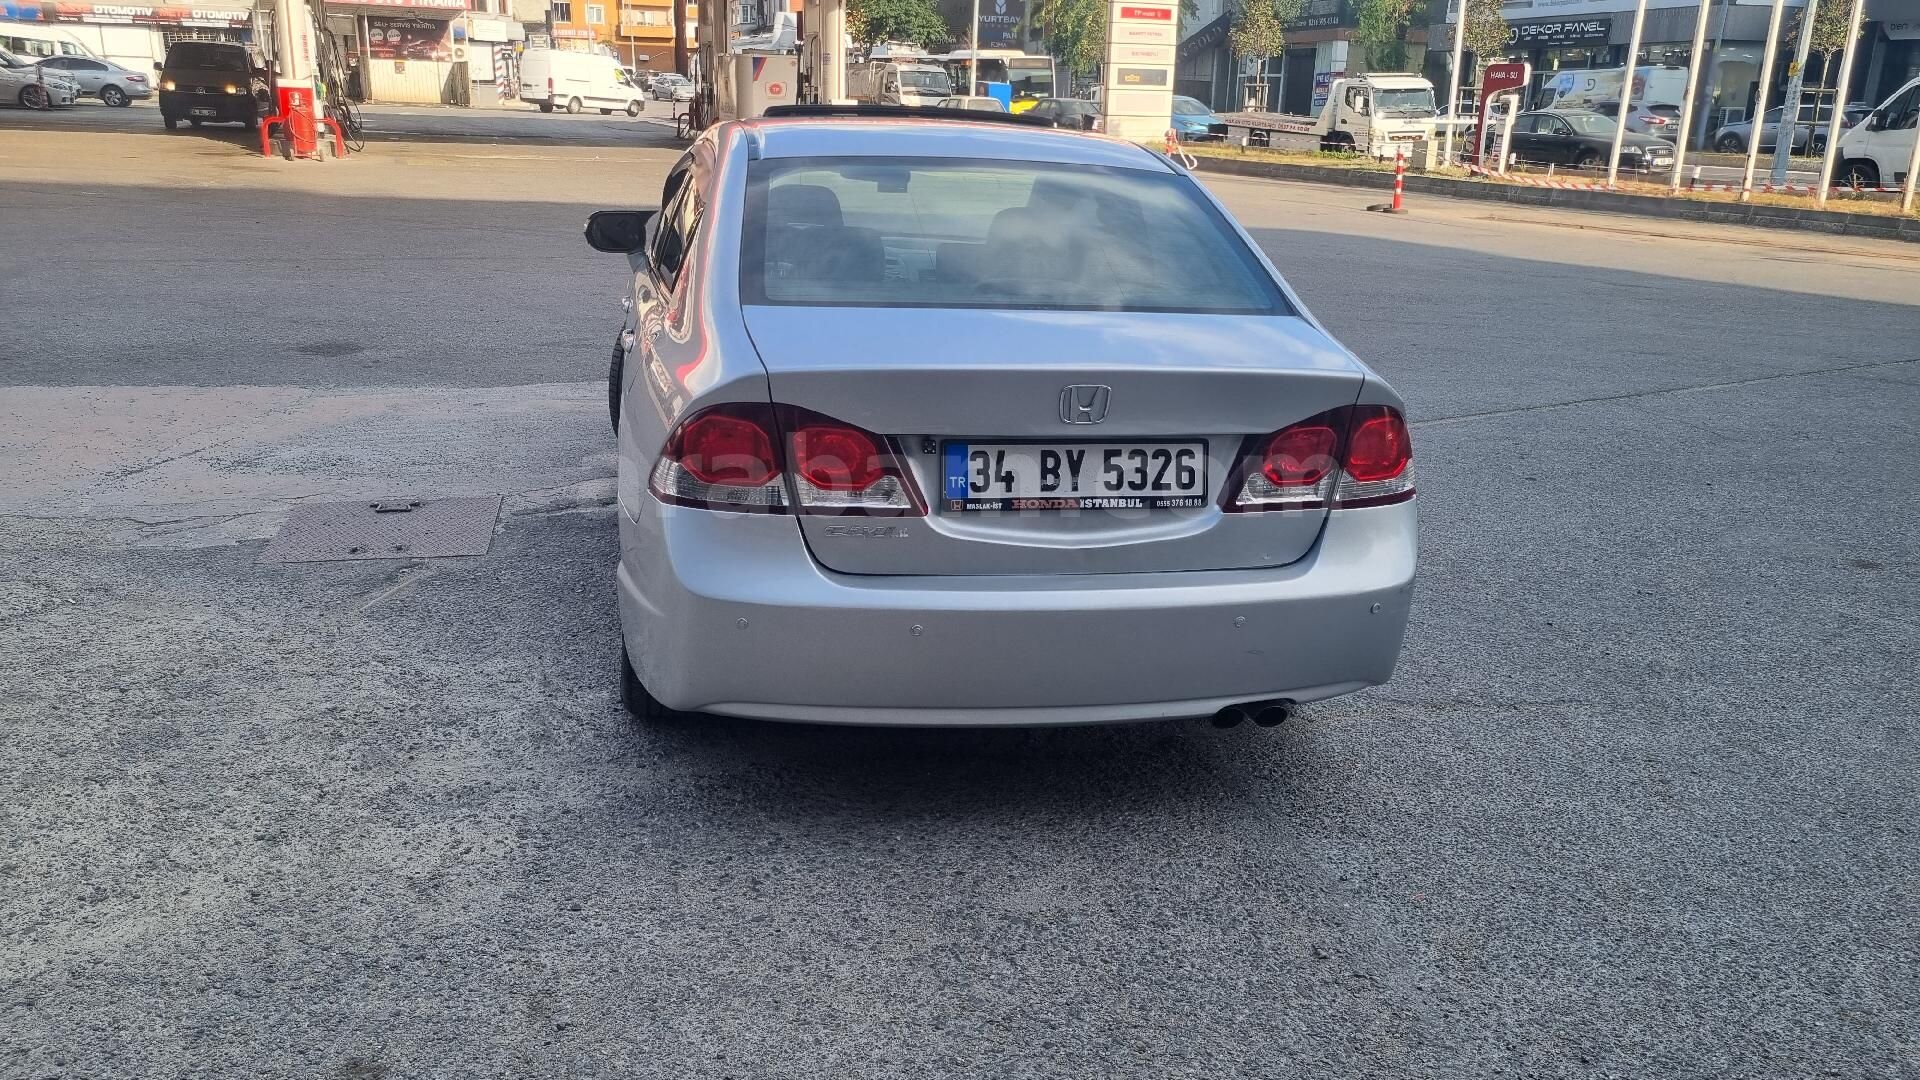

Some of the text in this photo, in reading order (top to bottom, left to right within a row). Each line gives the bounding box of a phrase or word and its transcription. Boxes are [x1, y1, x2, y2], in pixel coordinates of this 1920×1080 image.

[979, 15, 1021, 24] YURTBAY
[1521, 24, 1562, 35] DEKOR
[969, 448, 1196, 493] 34 BY 5326
[949, 476, 966, 488] TR
[1011, 499, 1080, 509] HONDA
